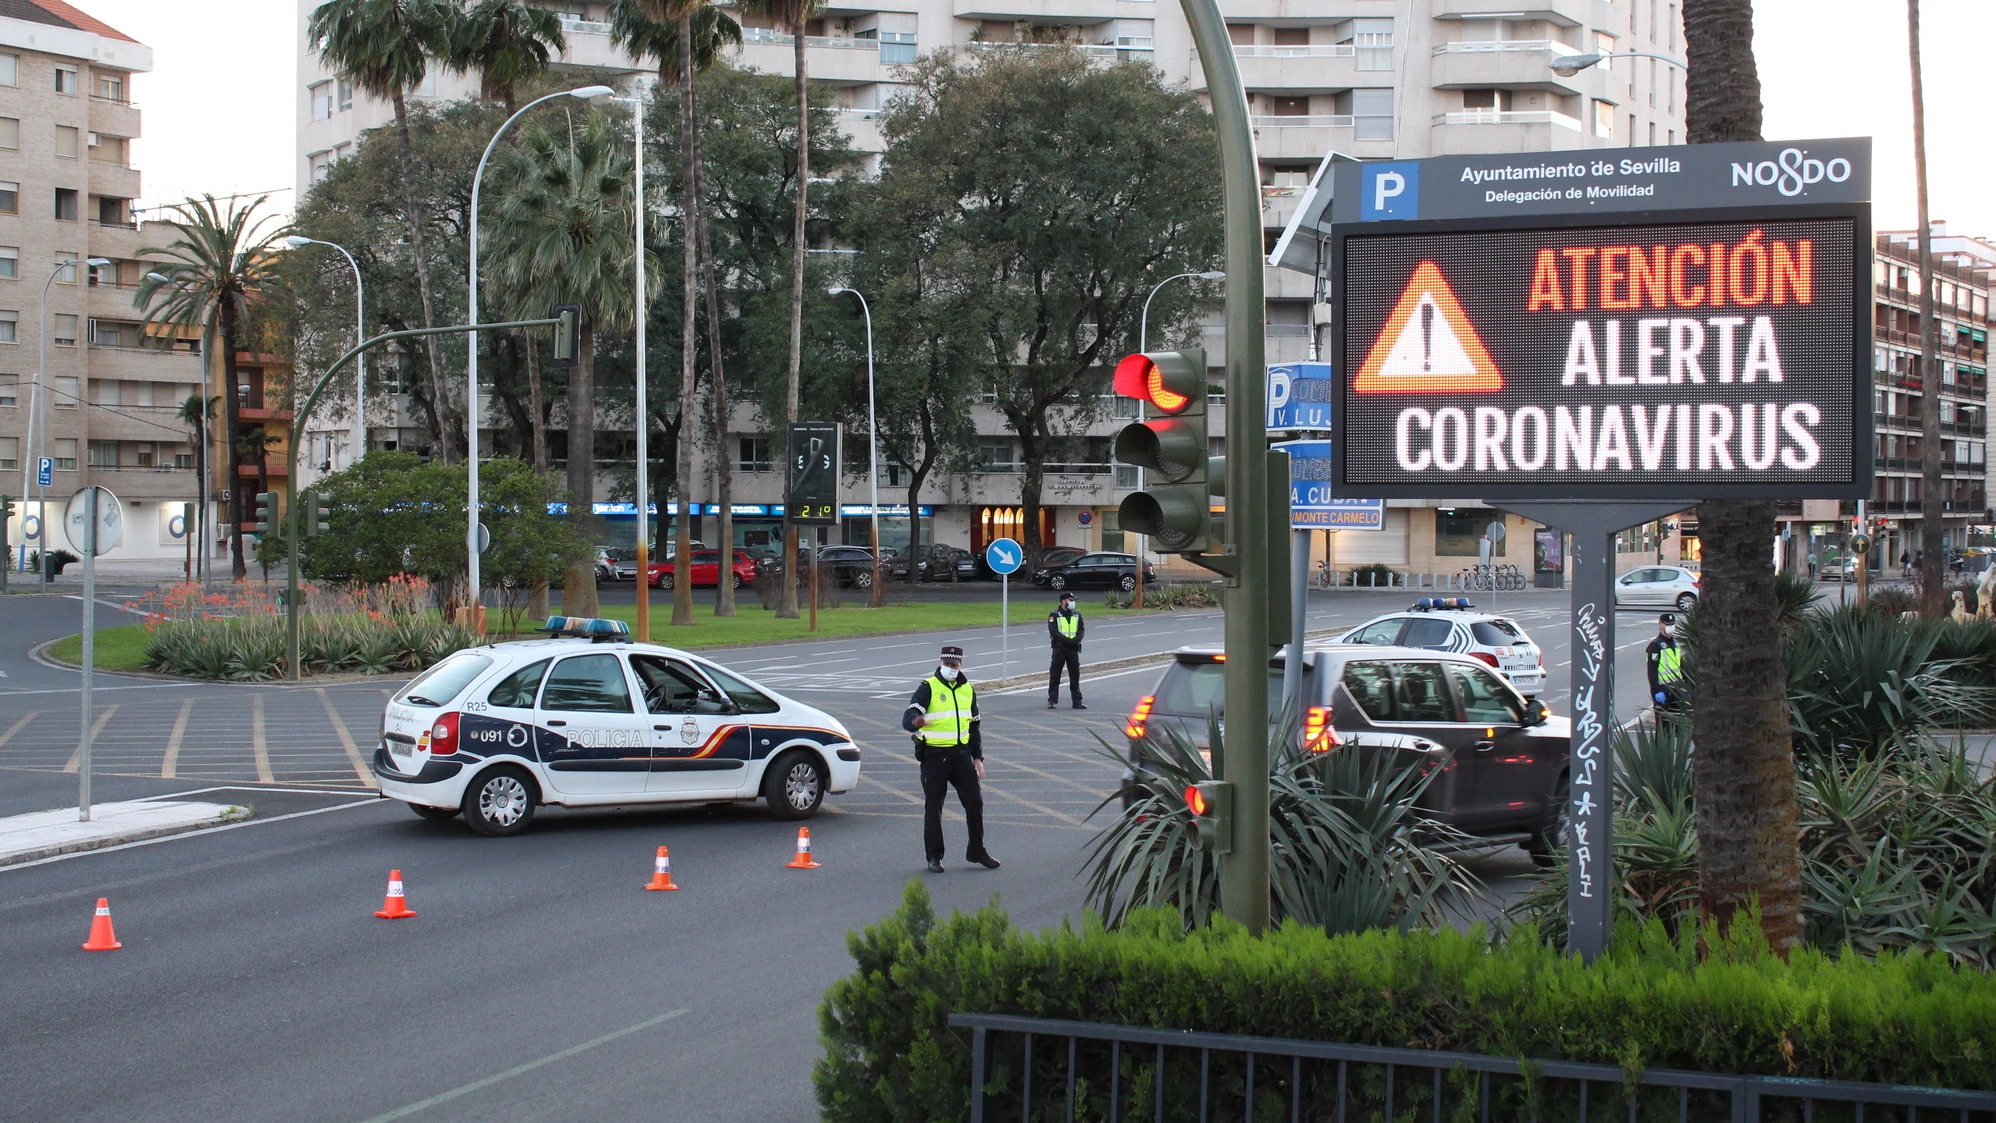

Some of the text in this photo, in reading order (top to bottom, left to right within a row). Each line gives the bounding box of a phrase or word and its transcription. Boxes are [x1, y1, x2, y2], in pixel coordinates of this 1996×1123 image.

[1460, 157, 1681, 184] Ayuntamiento de Sevilla
[1375, 172, 1406, 211] P
[1485, 184, 1655, 203] Delegación de Movilidad
[1527, 229, 1813, 312] ATENCIÓN
[1561, 315, 1785, 386] ALERTA
[1268, 372, 1290, 427] P
[1278, 409, 1288, 425] V.
[1395, 402, 1822, 473] CORONAVIRUS
[41, 458, 50, 472] P
[1329, 512, 1379, 524] CARMELO
[467, 702, 488, 712] R25
[480, 730, 502, 742] 091
[567, 729, 644, 749] POLICIA
